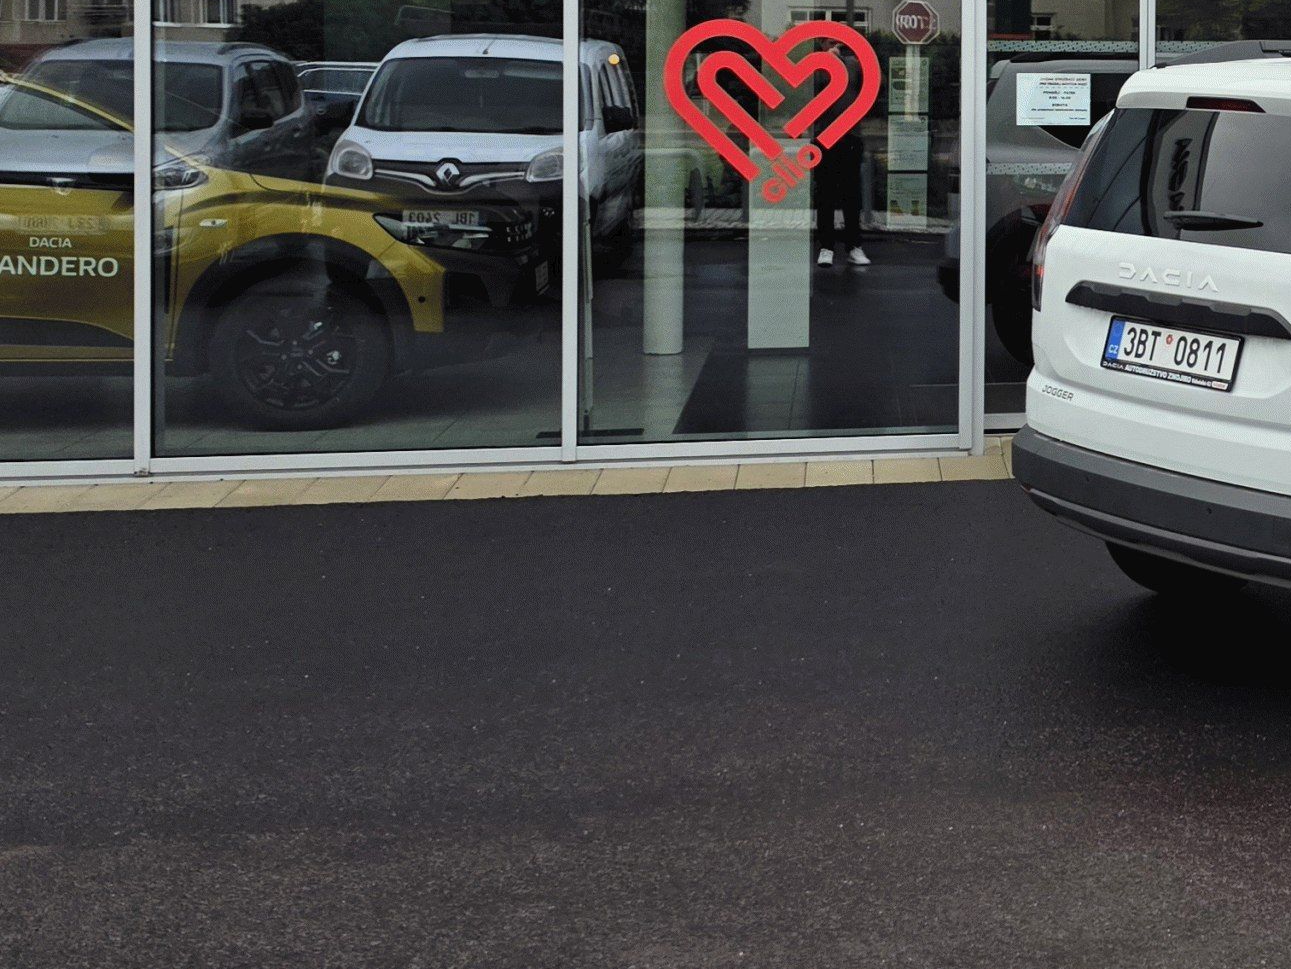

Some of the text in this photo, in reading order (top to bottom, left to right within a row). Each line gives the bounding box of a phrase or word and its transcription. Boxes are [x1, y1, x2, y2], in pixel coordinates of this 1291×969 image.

[29, 236, 72, 248] DACIA
[1119, 262, 1220, 293] DACIA
[1109, 344, 1119, 355] CZ
[1123, 327, 1227, 374] 3BT 0811
[1041, 384, 1074, 402] JOGGER
